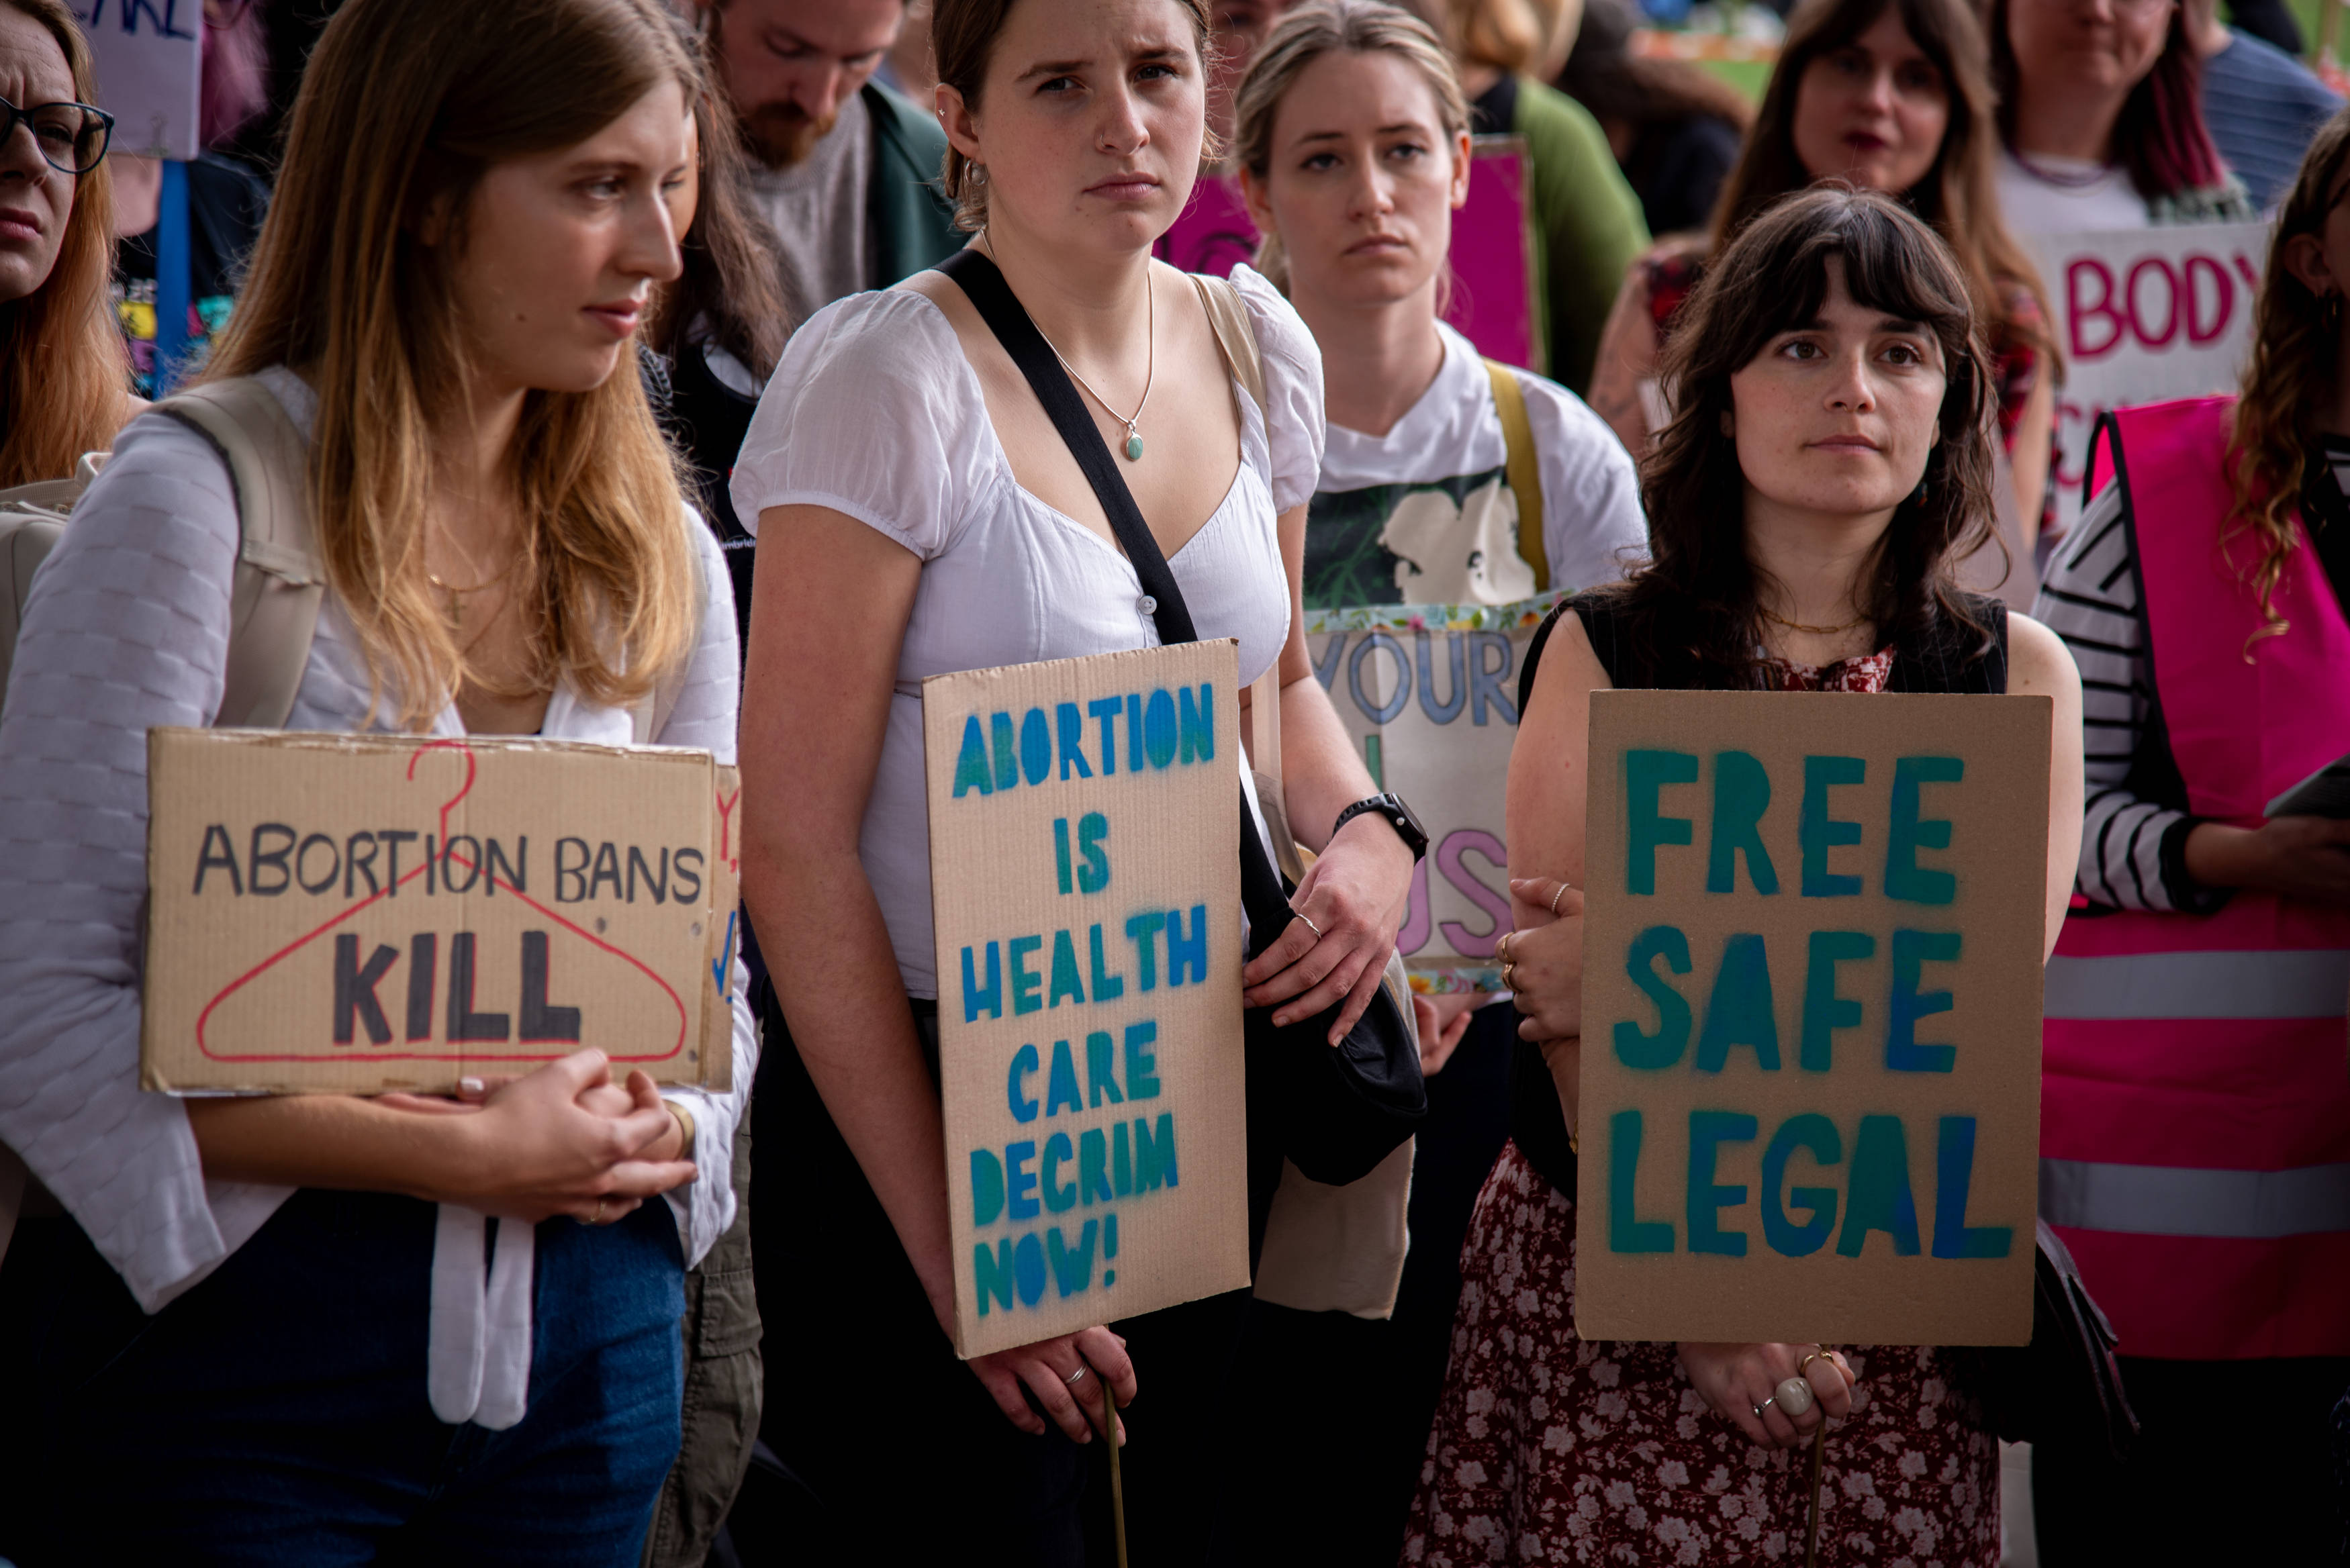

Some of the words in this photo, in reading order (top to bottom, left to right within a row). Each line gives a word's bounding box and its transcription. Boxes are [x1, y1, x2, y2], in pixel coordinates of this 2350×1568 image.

[952, 683, 1215, 799] ABORTION
[192, 823, 528, 898] ABORTION
[555, 836, 705, 905] BANS
[1053, 811, 1111, 895] IS
[1623, 749, 1965, 905] FREE
[332, 930, 581, 1046] KILL
[960, 904, 1207, 1024] HEALTH
[1613, 924, 1963, 1073] SAFE
[1008, 1020, 1161, 1124] CARE
[970, 1112, 1180, 1228] DECRIM
[1609, 1109, 2013, 1259] LEGAL
[974, 1213, 1119, 1318] NOW!
